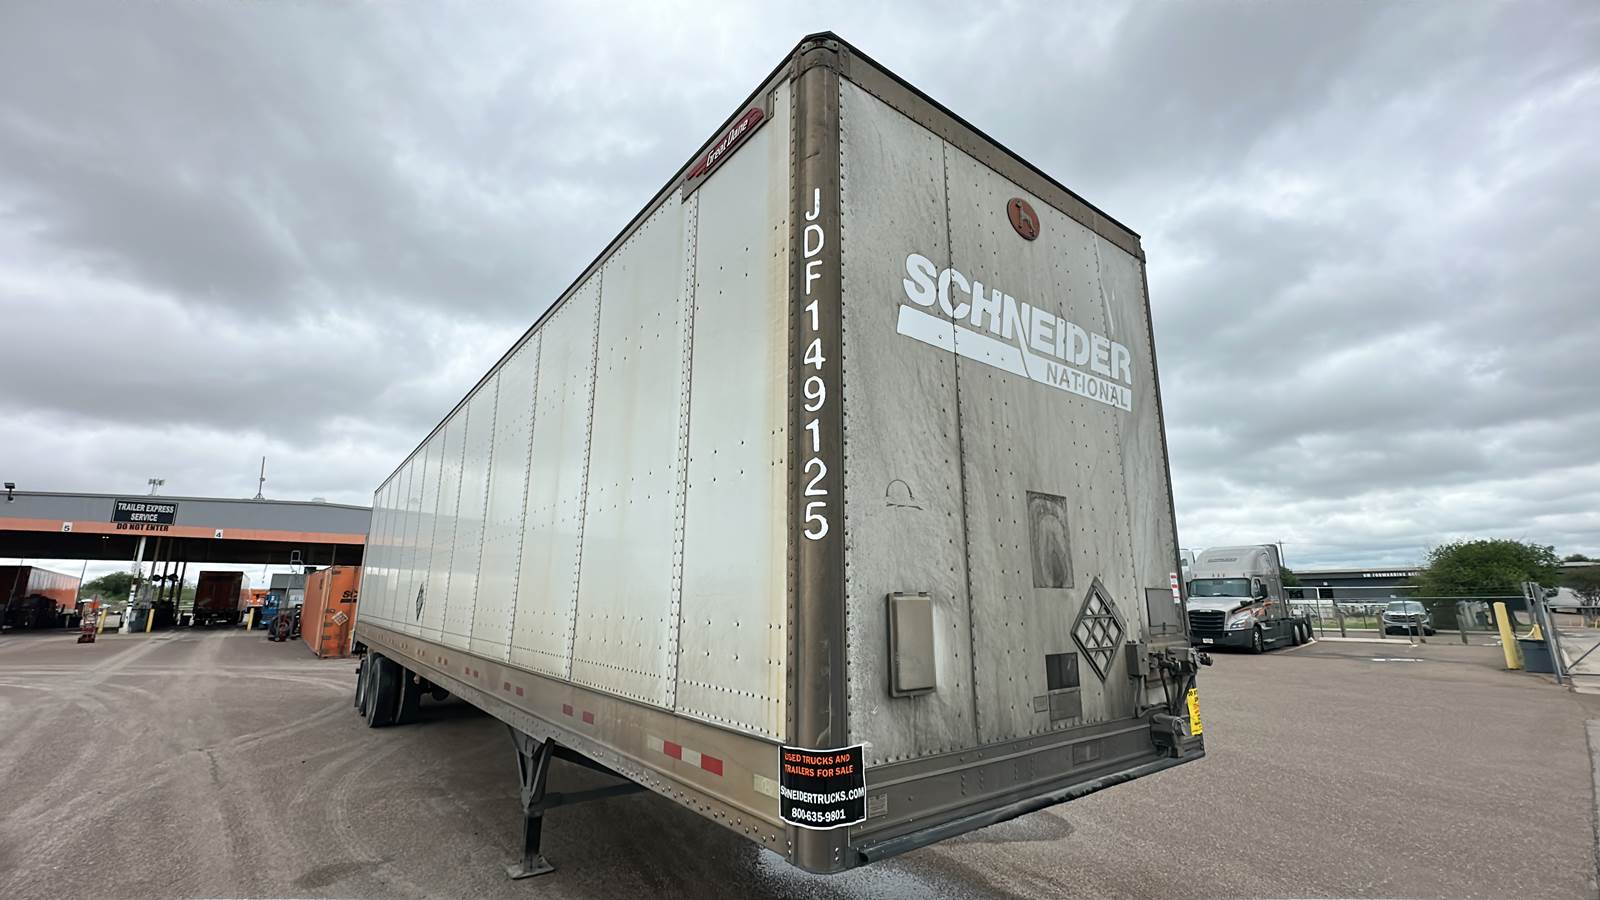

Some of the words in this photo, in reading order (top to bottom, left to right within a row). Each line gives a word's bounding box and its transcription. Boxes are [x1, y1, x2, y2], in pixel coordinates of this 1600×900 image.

[903, 253, 1132, 385] SCHNEIDER
[804, 188, 829, 540] JDF149125
[1046, 363, 1128, 408] NATIONAL
[118, 502, 145, 512] TRAILER
[146, 505, 174, 513] EXPRESS
[131, 513, 158, 522] SERVICE
[146, 524, 169, 532] ENTER
[785, 753, 801, 762] USED
[802, 755, 833, 765] TRUCKS
[835, 754, 850, 763] AND
[784, 764, 815, 776] TRAILERS
[817, 769, 834, 777] FOR
[835, 765, 854, 775] SALE
[791, 808, 846, 822] 800-635-9801
